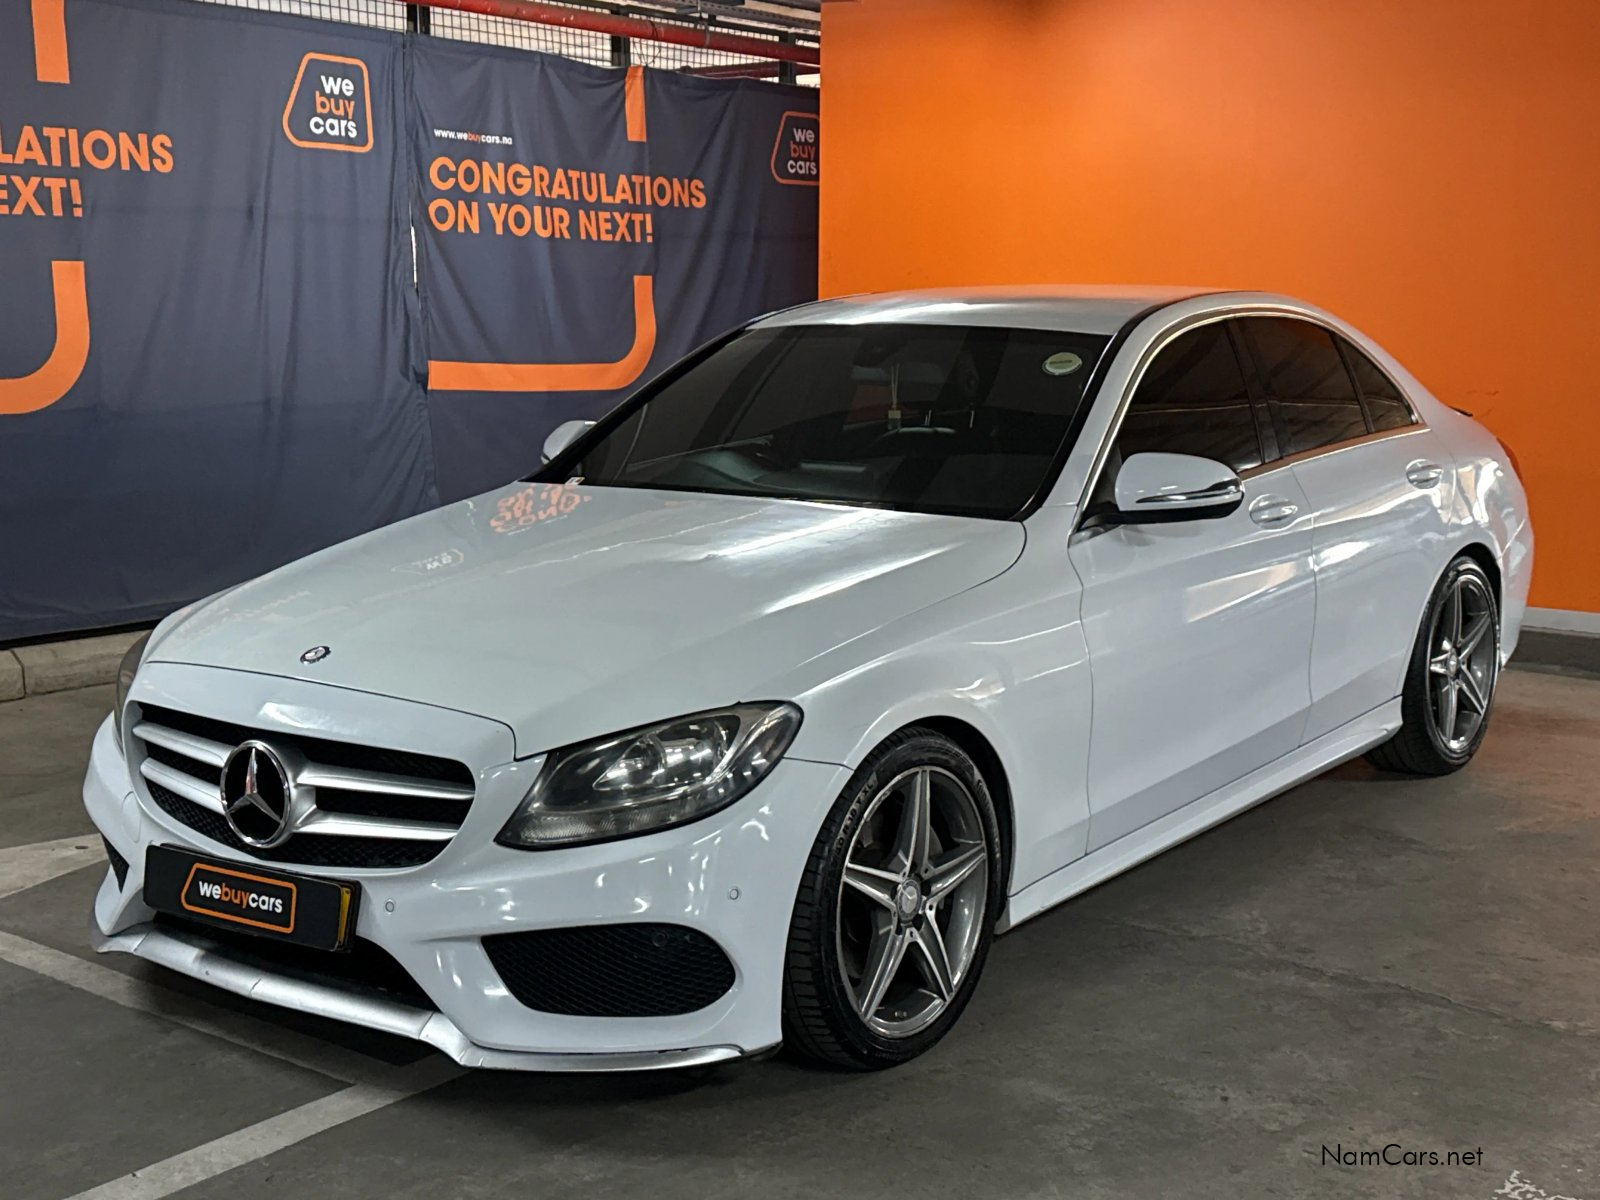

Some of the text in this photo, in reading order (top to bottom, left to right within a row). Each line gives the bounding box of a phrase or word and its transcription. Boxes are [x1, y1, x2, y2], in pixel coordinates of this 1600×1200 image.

[320, 75, 355, 97] we
[315, 90, 356, 120] buy
[309, 116, 358, 138] cars
[433, 128, 513, 145] www.webuycars.na
[793, 128, 815, 143] we
[790, 140, 816, 161] buy
[787, 160, 817, 175] cars
[429, 156, 706, 209] CONGRATULATIONS
[428, 198, 653, 243] ON YOUR NEXT!
[198, 880, 283, 913] webuycars
